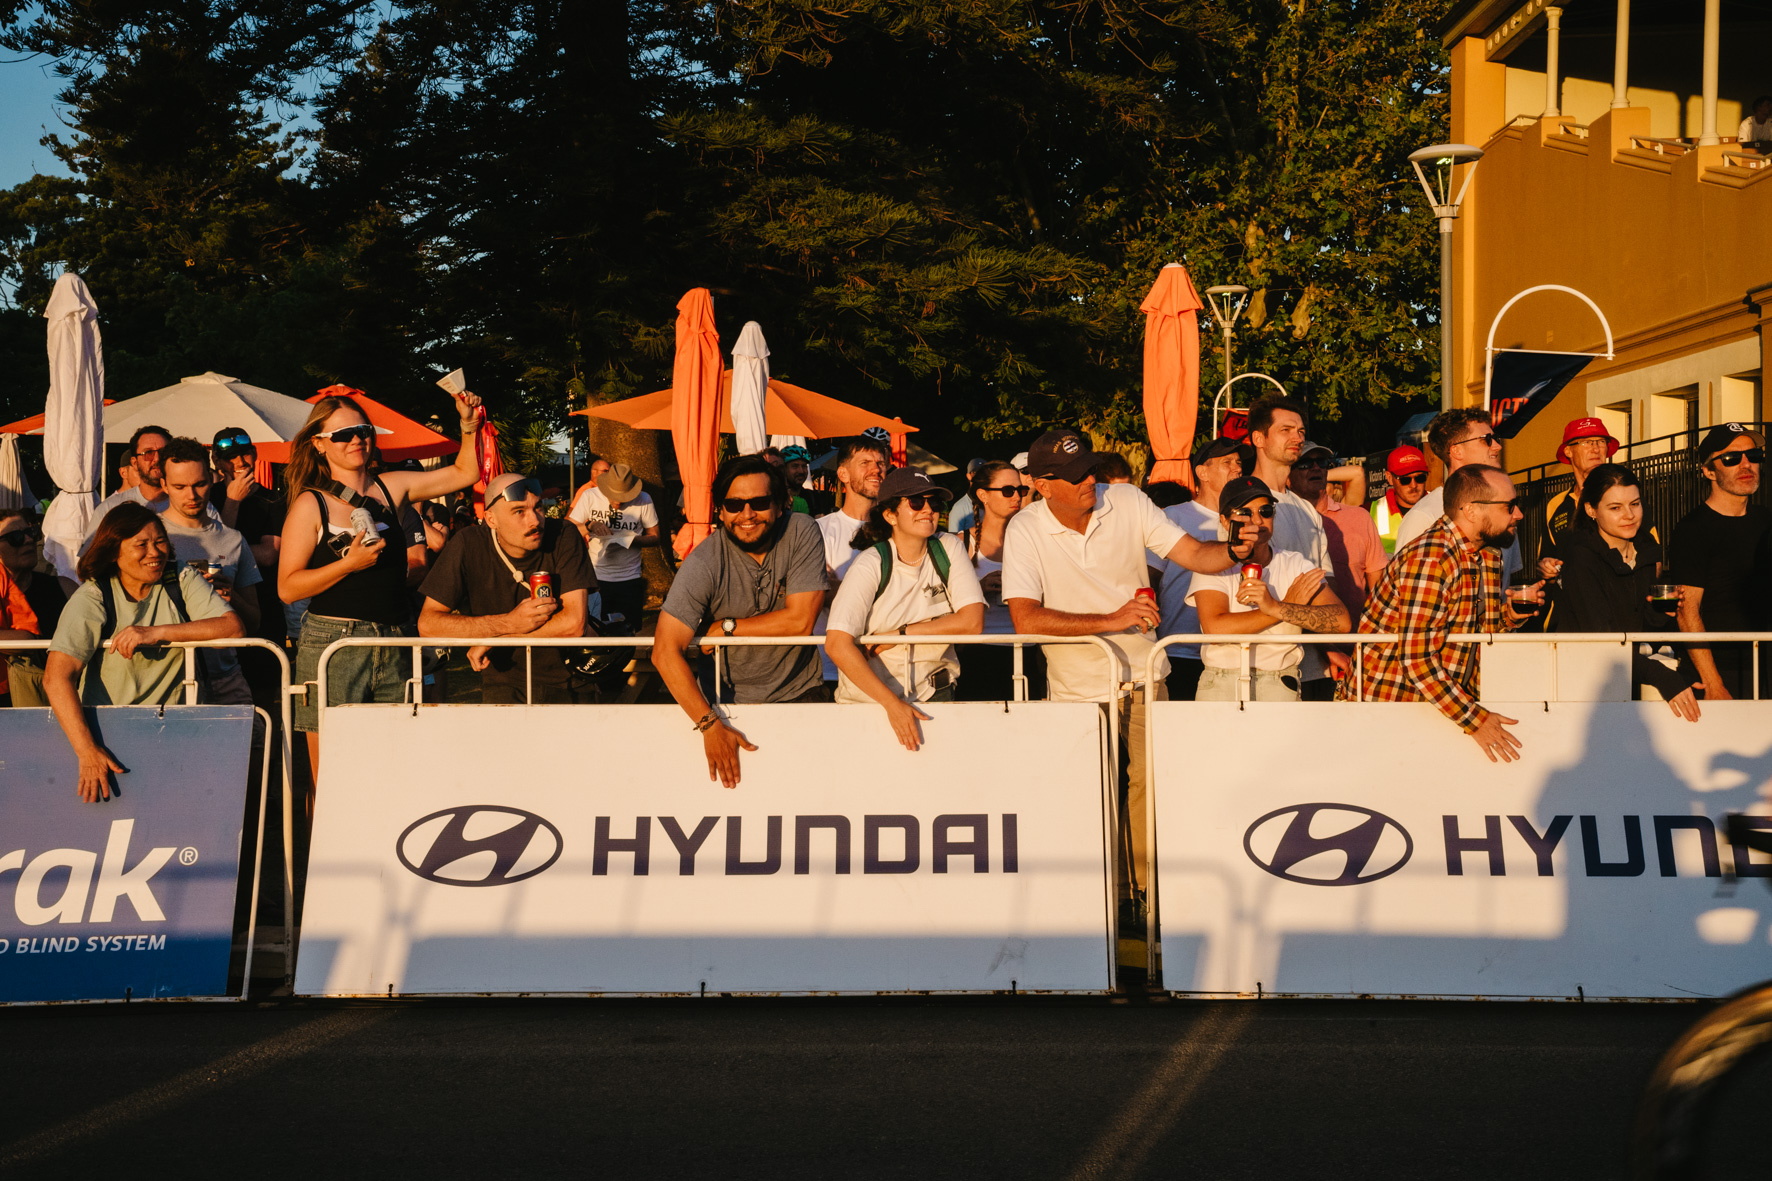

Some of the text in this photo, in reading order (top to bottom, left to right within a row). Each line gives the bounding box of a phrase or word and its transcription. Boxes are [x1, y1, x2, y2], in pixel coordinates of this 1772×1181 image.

[591, 518, 640, 531] UBAIX
[592, 813, 1018, 876] HYUNDAI
[15, 937, 80, 954] BLIND
[85, 934, 167, 952] SYSTEM
